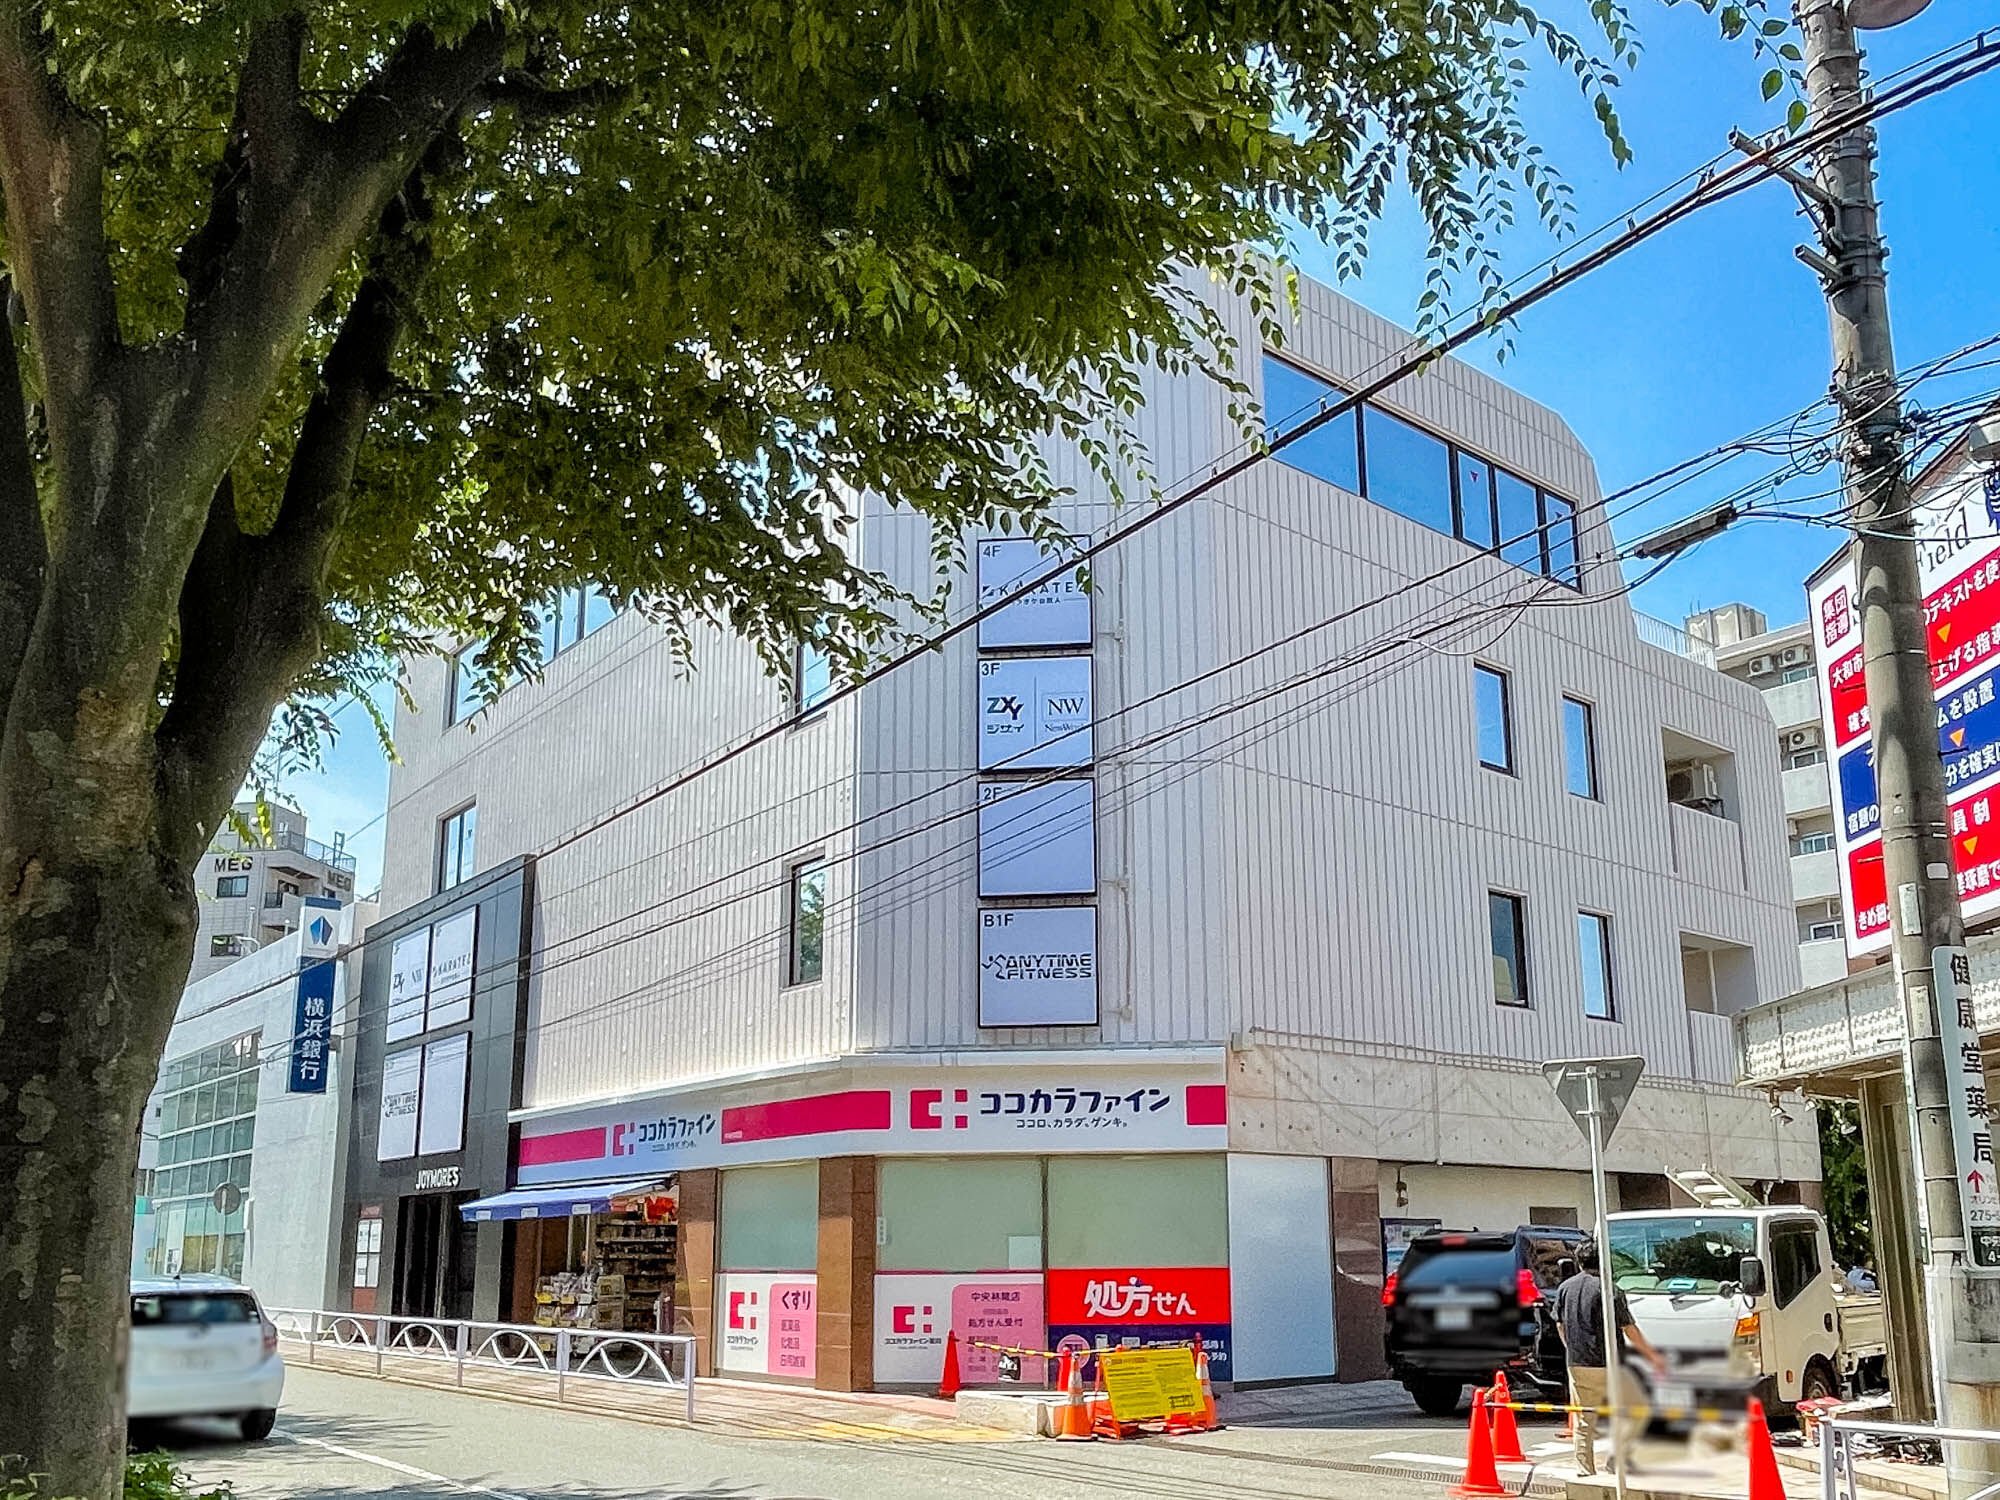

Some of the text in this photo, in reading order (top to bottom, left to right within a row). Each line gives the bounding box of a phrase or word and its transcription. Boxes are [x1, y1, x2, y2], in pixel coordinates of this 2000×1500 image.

[982, 545, 1000, 557] 4F
[981, 664, 1000, 676] 3F
[987, 696, 1024, 720] ZXY
[1047, 698, 1084, 715] NW
[983, 788, 1000, 801] 2F
[983, 914, 1014, 927] B1F
[1005, 953, 1092, 969] ANYTIME
[1006, 967, 1092, 980] FITNESS
[300, 997, 325, 1080] 横浜銀行
[980, 1088, 1170, 1114] ココカラファイン
[639, 1114, 716, 1142] ココカラファイン
[781, 1290, 811, 1310] くすり
[1085, 1277, 1196, 1317] 処方せん
